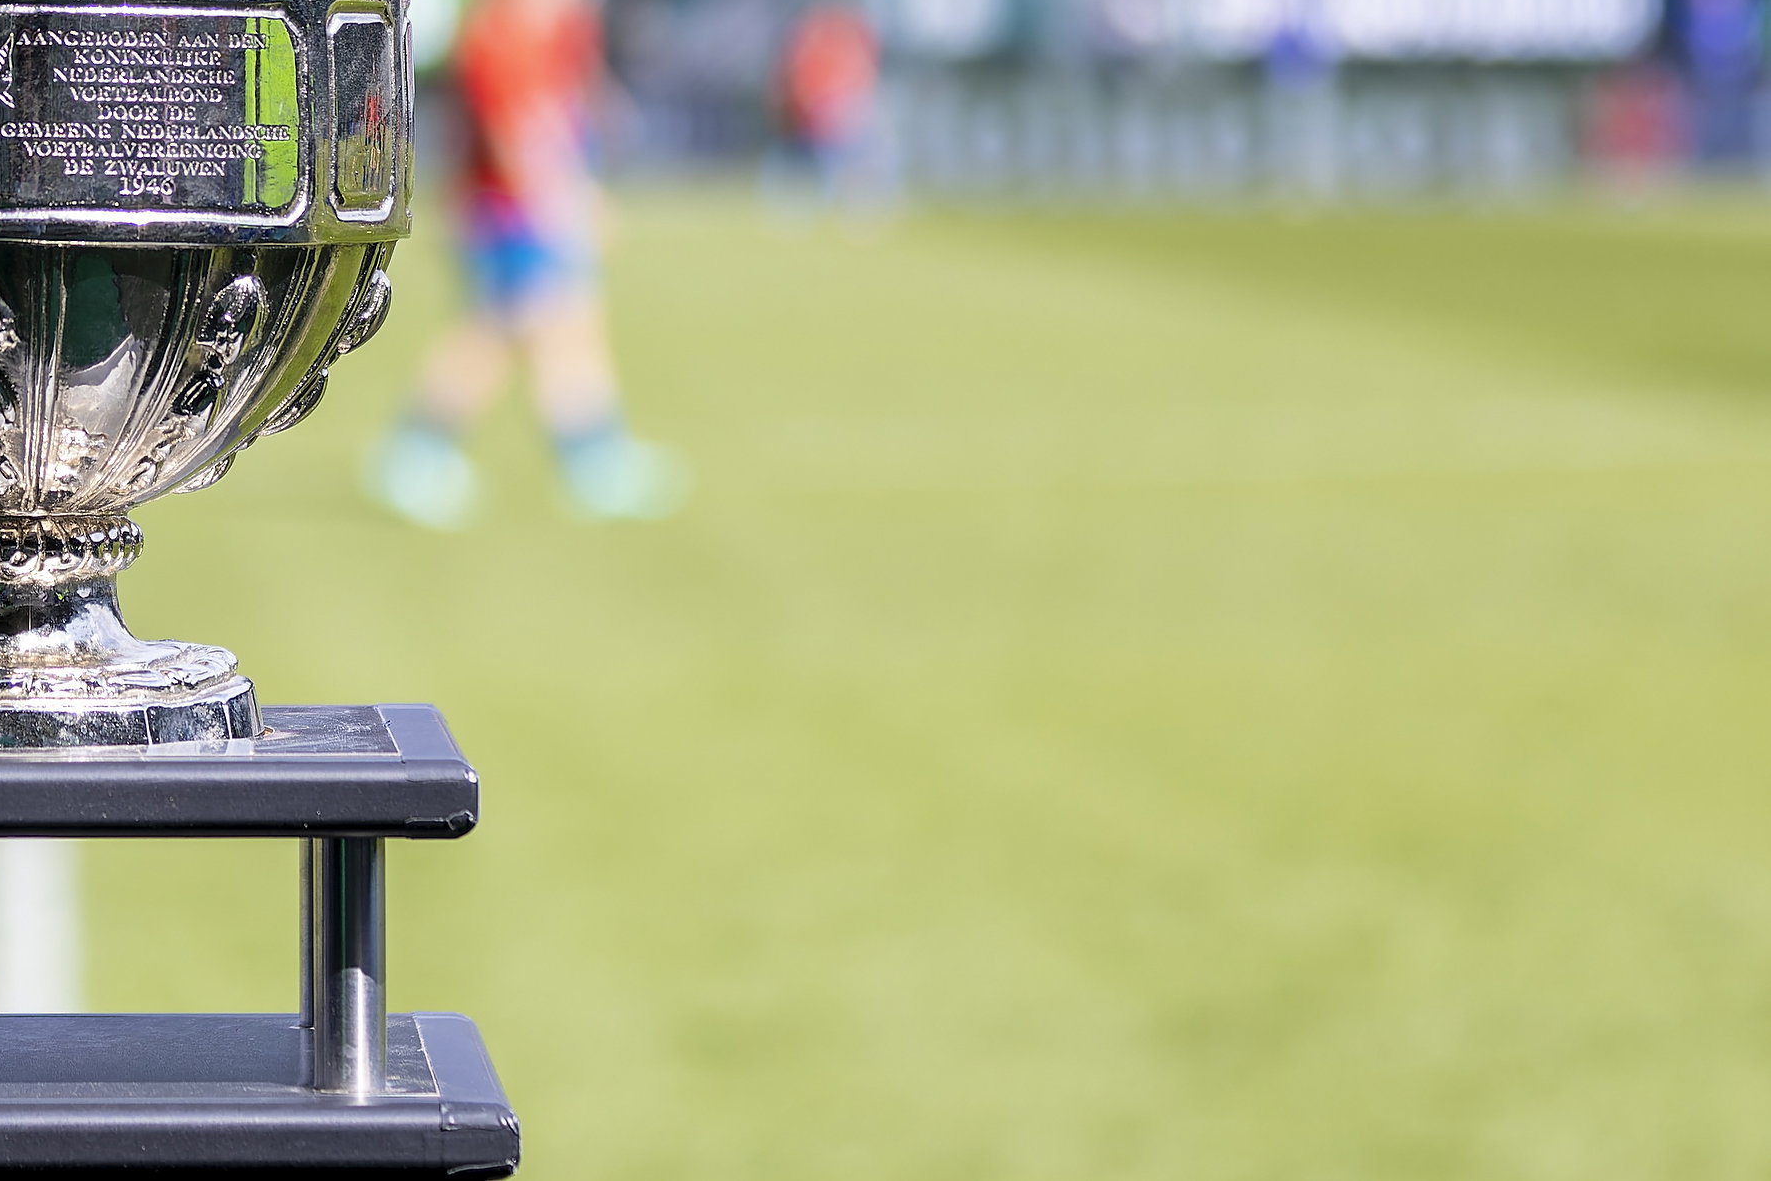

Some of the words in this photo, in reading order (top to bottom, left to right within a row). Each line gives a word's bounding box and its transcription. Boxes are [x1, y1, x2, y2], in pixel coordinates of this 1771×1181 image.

[16, 29, 167, 48] AANGEBODEN
[178, 32, 220, 49] AAN
[229, 32, 266, 49] DEN
[73, 48, 221, 67] KONINKLIJKE
[52, 67, 236, 85] NEDERLANDSCHE
[69, 86, 223, 103] VOETBALBOND
[97, 104, 159, 121] DOOR
[167, 105, 196, 121] DE
[121, 123, 290, 141] NEDERLANDSCHE
[23, 140, 262, 160] VOETBALVEREENIGING
[63, 159, 94, 176] DE
[104, 160, 226, 177] ZWALUWEN
[119, 176, 175, 196] 1946
